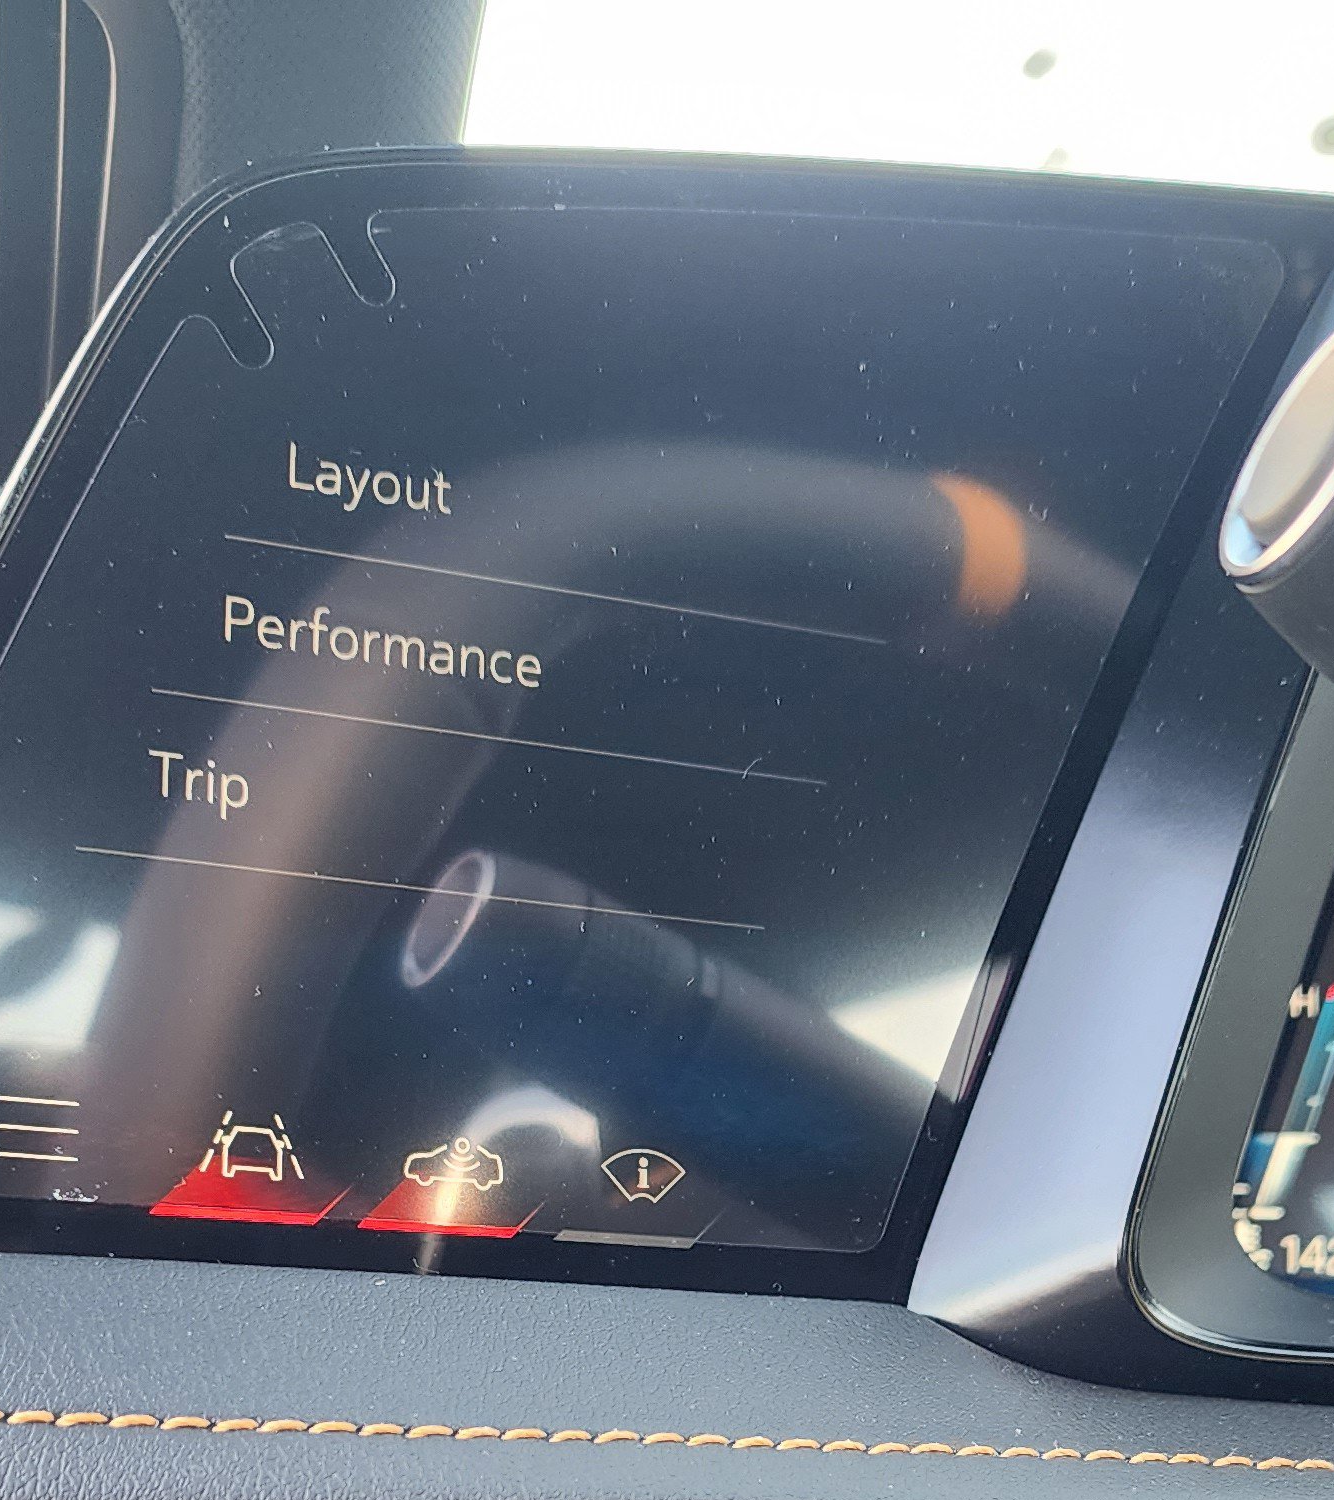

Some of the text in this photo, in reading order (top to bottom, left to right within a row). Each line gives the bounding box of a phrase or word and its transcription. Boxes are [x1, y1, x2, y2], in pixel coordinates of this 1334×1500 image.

[287, 440, 452, 515] Layout
[223, 595, 543, 688] Performance
[148, 749, 250, 819] Trip
